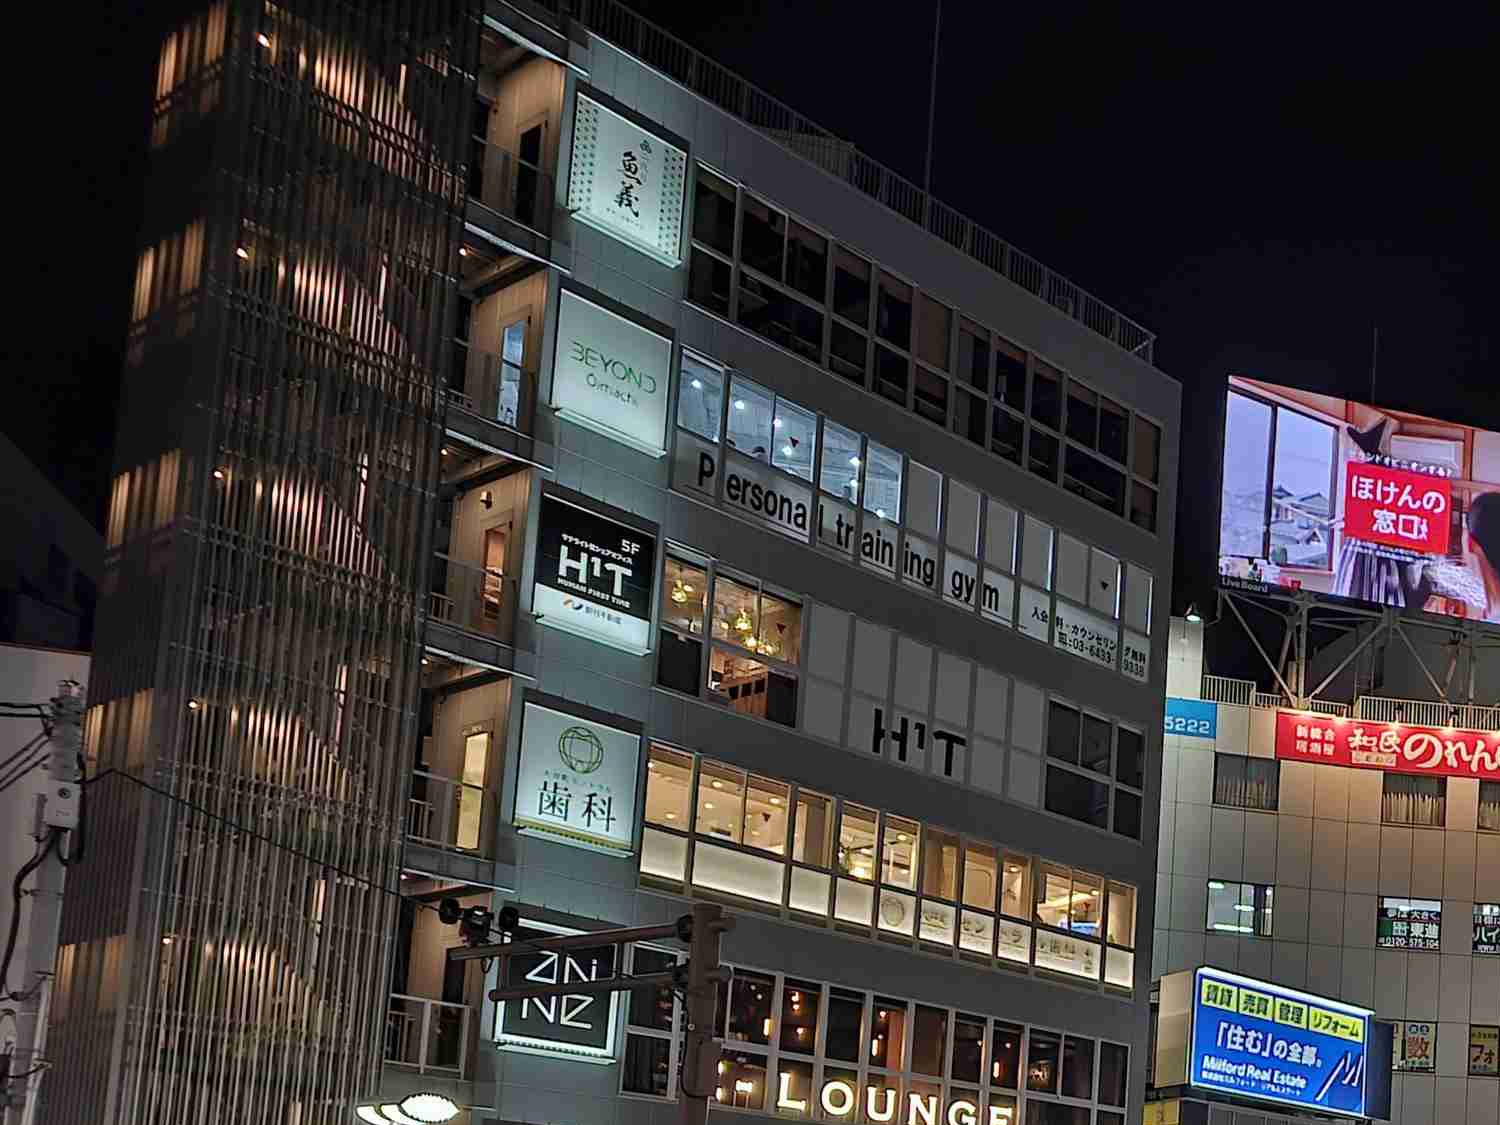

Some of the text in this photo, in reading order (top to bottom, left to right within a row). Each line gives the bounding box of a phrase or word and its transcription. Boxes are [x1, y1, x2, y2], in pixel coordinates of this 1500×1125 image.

[570, 339, 656, 394] BEYOND
[1352, 475, 1446, 514] ほけんの
[699, 451, 999, 612] Personal training gym
[1372, 509, 1419, 540] 窓口
[621, 539, 641, 555] 5F
[558, 544, 633, 597] H1T
[538, 780, 617, 833] 歯科
[1409, 921, 1440, 940] 東進
[1279, 1002, 1304, 1025] 管理
[1312, 1010, 1360, 1038] リフォーム
[1247, 1065, 1272, 1081] Real
[1273, 1068, 1307, 1088] Estate
